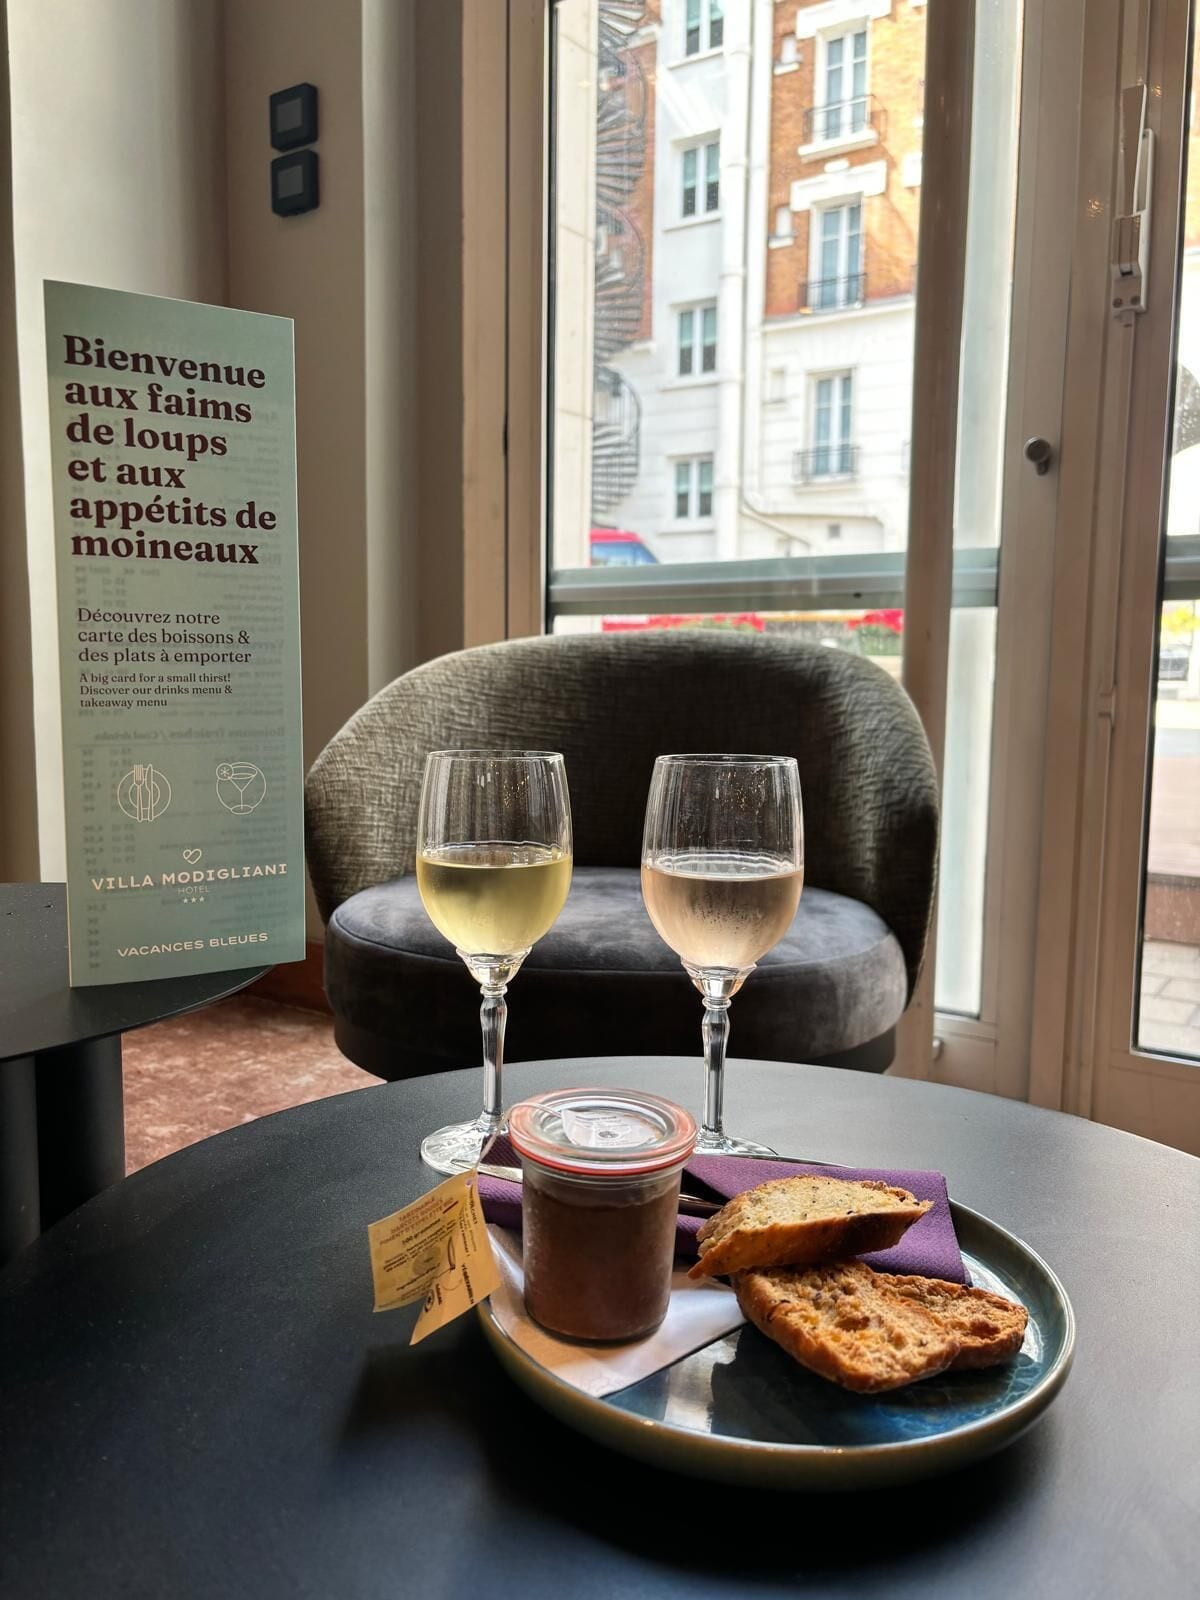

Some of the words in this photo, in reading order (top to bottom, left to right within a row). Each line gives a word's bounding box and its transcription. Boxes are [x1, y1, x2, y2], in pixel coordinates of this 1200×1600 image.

[63, 334, 266, 388] Bienvenue
[65, 382, 138, 411] aux
[147, 382, 252, 423] faims
[66, 413, 114, 445] de
[124, 417, 227, 462] loups
[68, 458, 107, 483] et
[116, 463, 186, 489] aux
[70, 494, 227, 530] appétits
[235, 501, 277, 530] de
[71, 530, 259, 564] moineaux
[77, 607, 171, 624] Découvrez
[175, 611, 221, 625] notre
[78, 629, 123, 643] carte
[128, 628, 157, 643] des
[162, 629, 234, 645] boissons
[237, 630, 250, 645] &
[78, 648, 109, 662] des
[113, 648, 155, 666] plats
[160, 649, 170, 663] à
[174, 651, 252, 666] emporter
[79, 673, 88, 683] A
[90, 673, 109, 685] big
[111, 673, 136, 683] card
[138, 673, 156, 683] for
[158, 675, 164, 683] a
[166, 673, 196, 683] small
[198, 673, 231, 683] thirst!
[79, 685, 129, 695] Discover
[132, 687, 151, 695] our
[154, 685, 190, 695] drinks
[192, 687, 222, 695] menu
[224, 685, 233, 695] &
[80, 698, 133, 709] takeaway
[136, 699, 168, 707] menu
[91, 874, 154, 891] VILLA
[162, 863, 288, 885] MODIGLIANI
[177, 886, 210, 895] HOTEL
[117, 939, 204, 957] VACANCES
[209, 932, 269, 948] BLEUES
